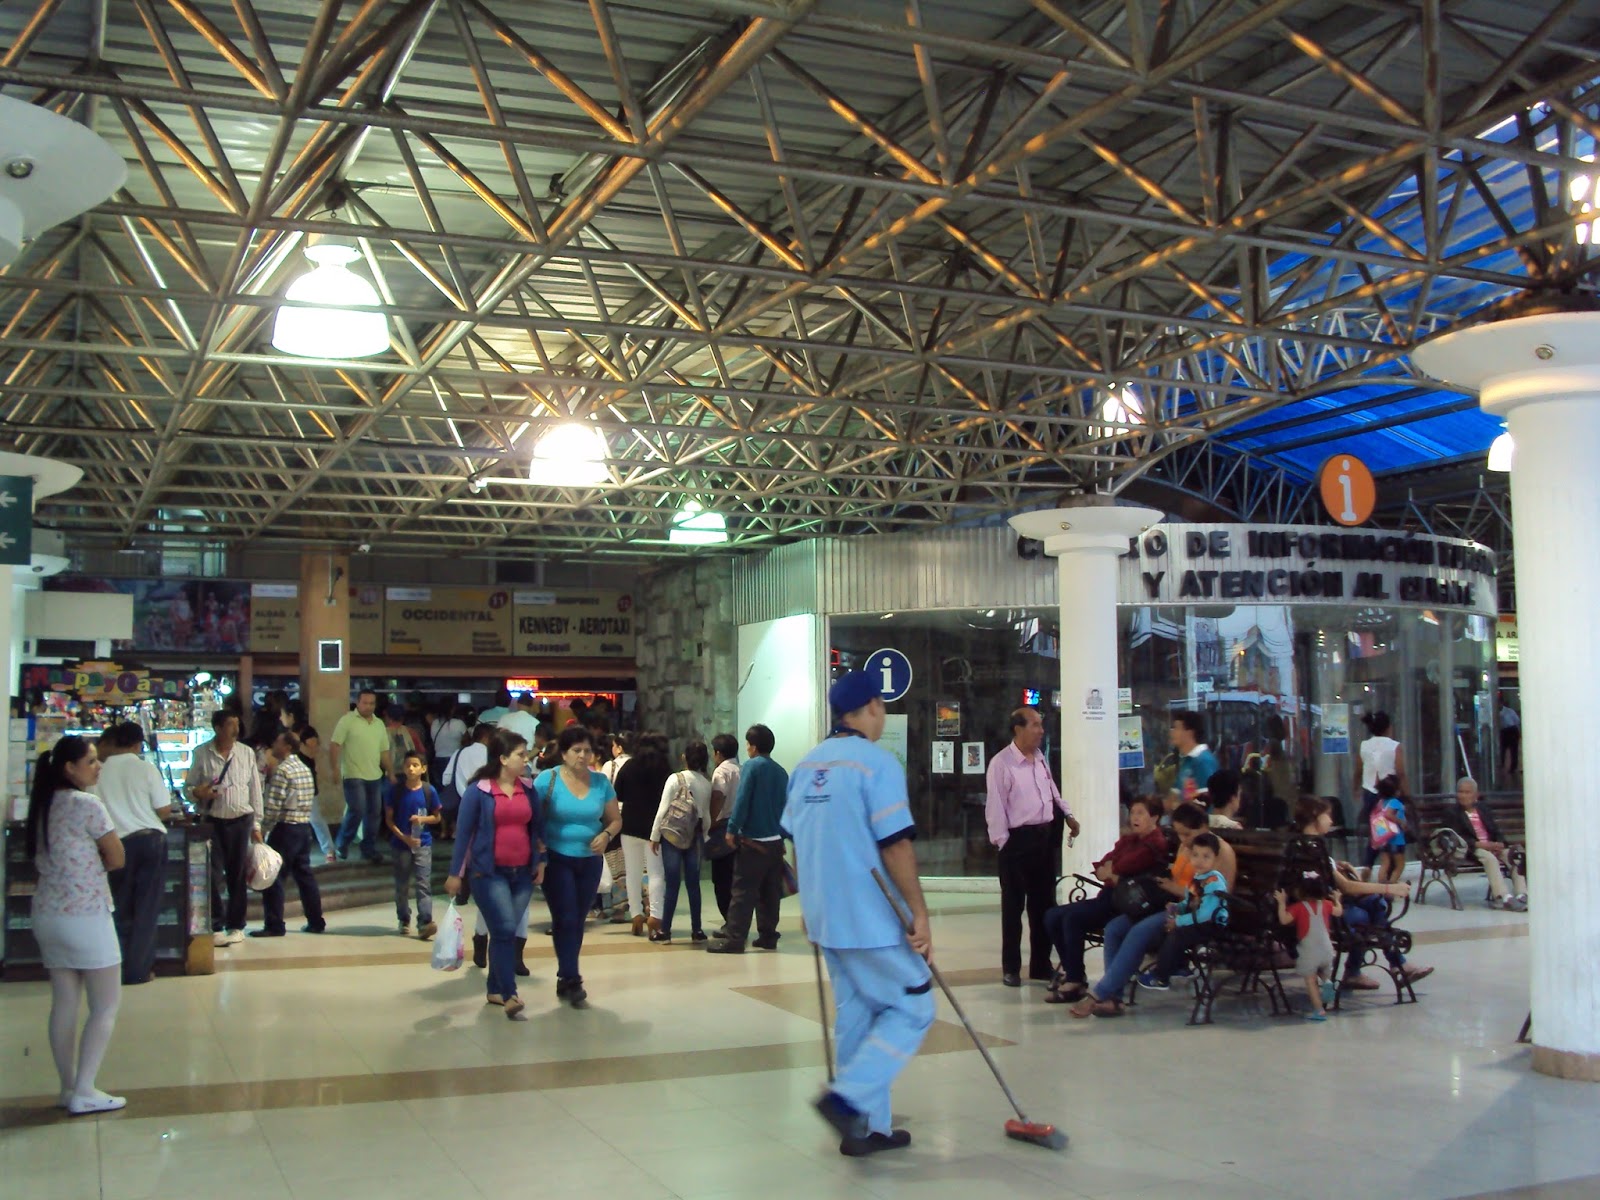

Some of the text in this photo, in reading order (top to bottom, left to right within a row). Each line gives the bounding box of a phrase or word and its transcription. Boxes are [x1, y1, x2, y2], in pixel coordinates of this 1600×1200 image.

[1186, 530, 1231, 558] DE
[1143, 561, 1476, 605] Y ATENCIÓN AL CLIENTE
[402, 609, 495, 621] OCCIDENTAL
[519, 615, 570, 634] KENNEDY
[578, 616, 631, 635] AEROTAXI
